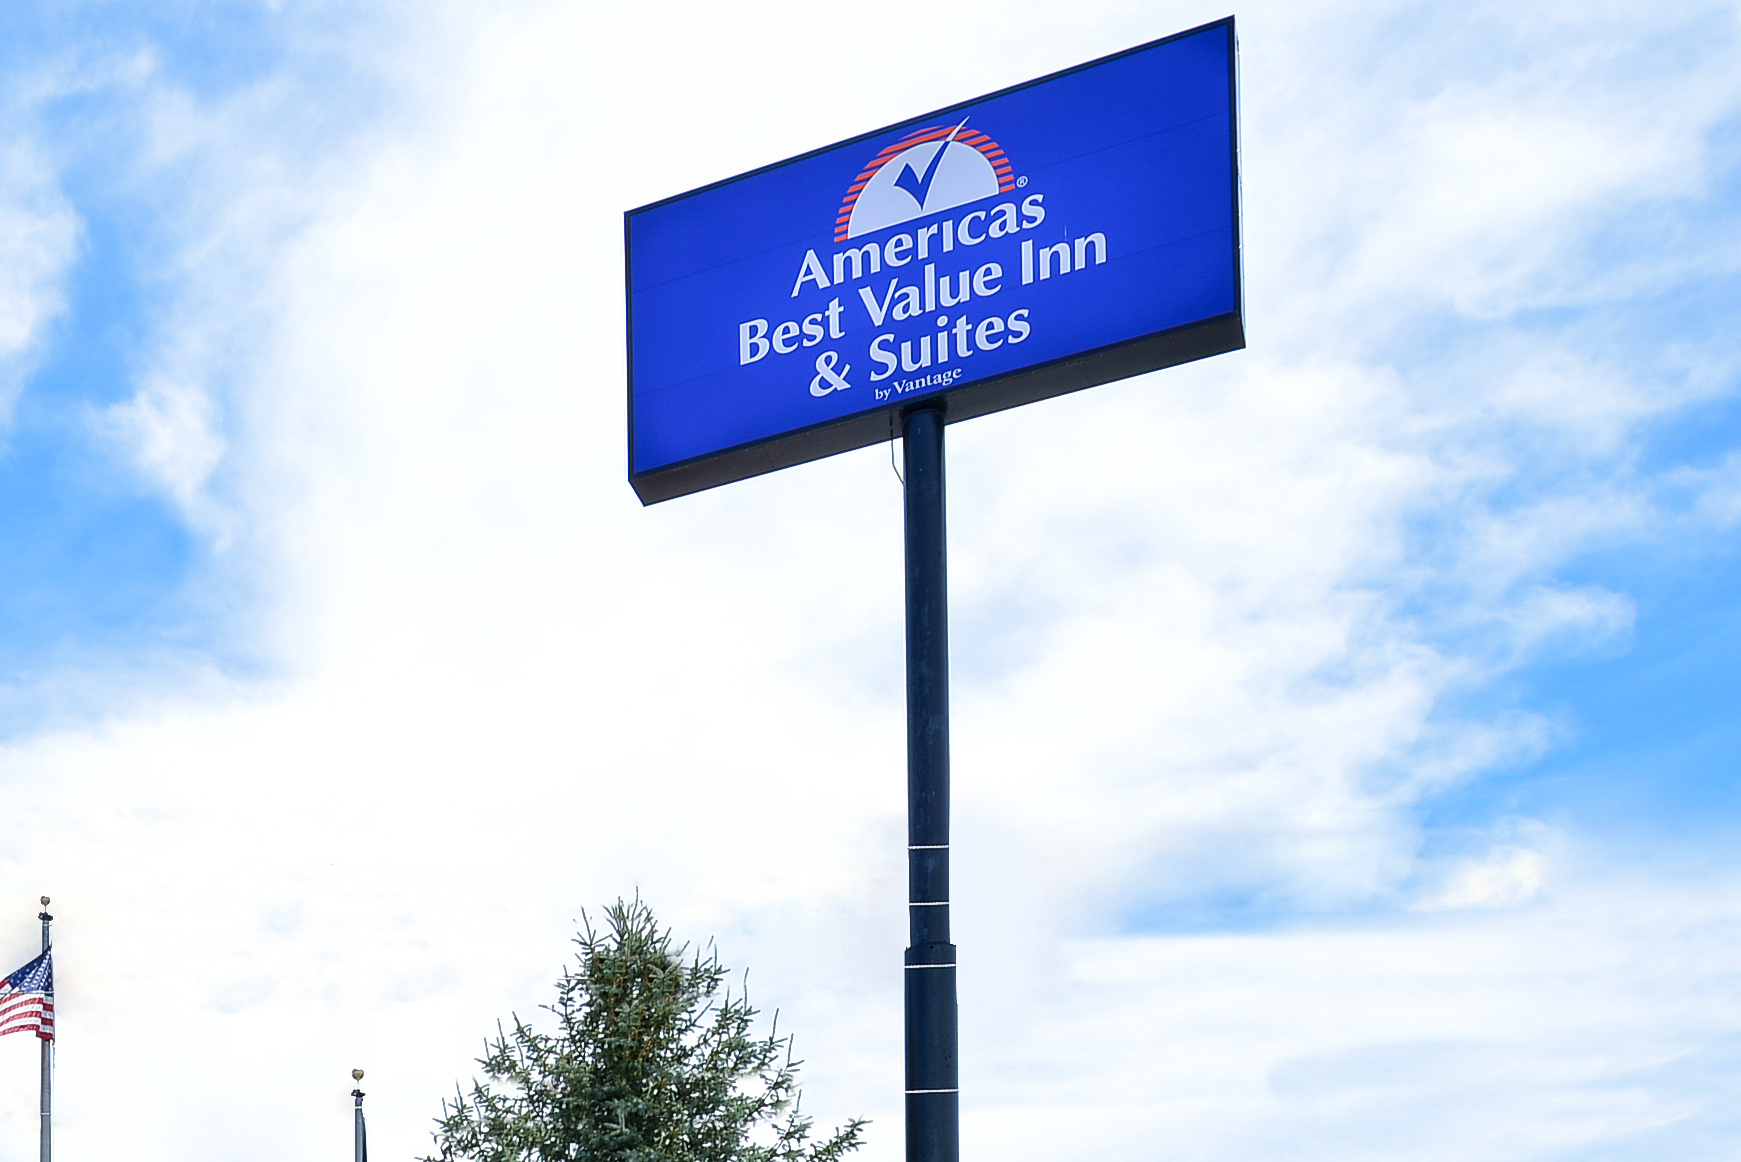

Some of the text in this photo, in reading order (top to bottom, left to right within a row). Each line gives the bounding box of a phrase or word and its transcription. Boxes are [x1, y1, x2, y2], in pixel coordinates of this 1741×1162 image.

[791, 193, 1046, 298] Americas
[739, 231, 1107, 366] Best Value Inn
[809, 308, 1030, 397] & Suites
[875, 367, 963, 401] by Vantage
